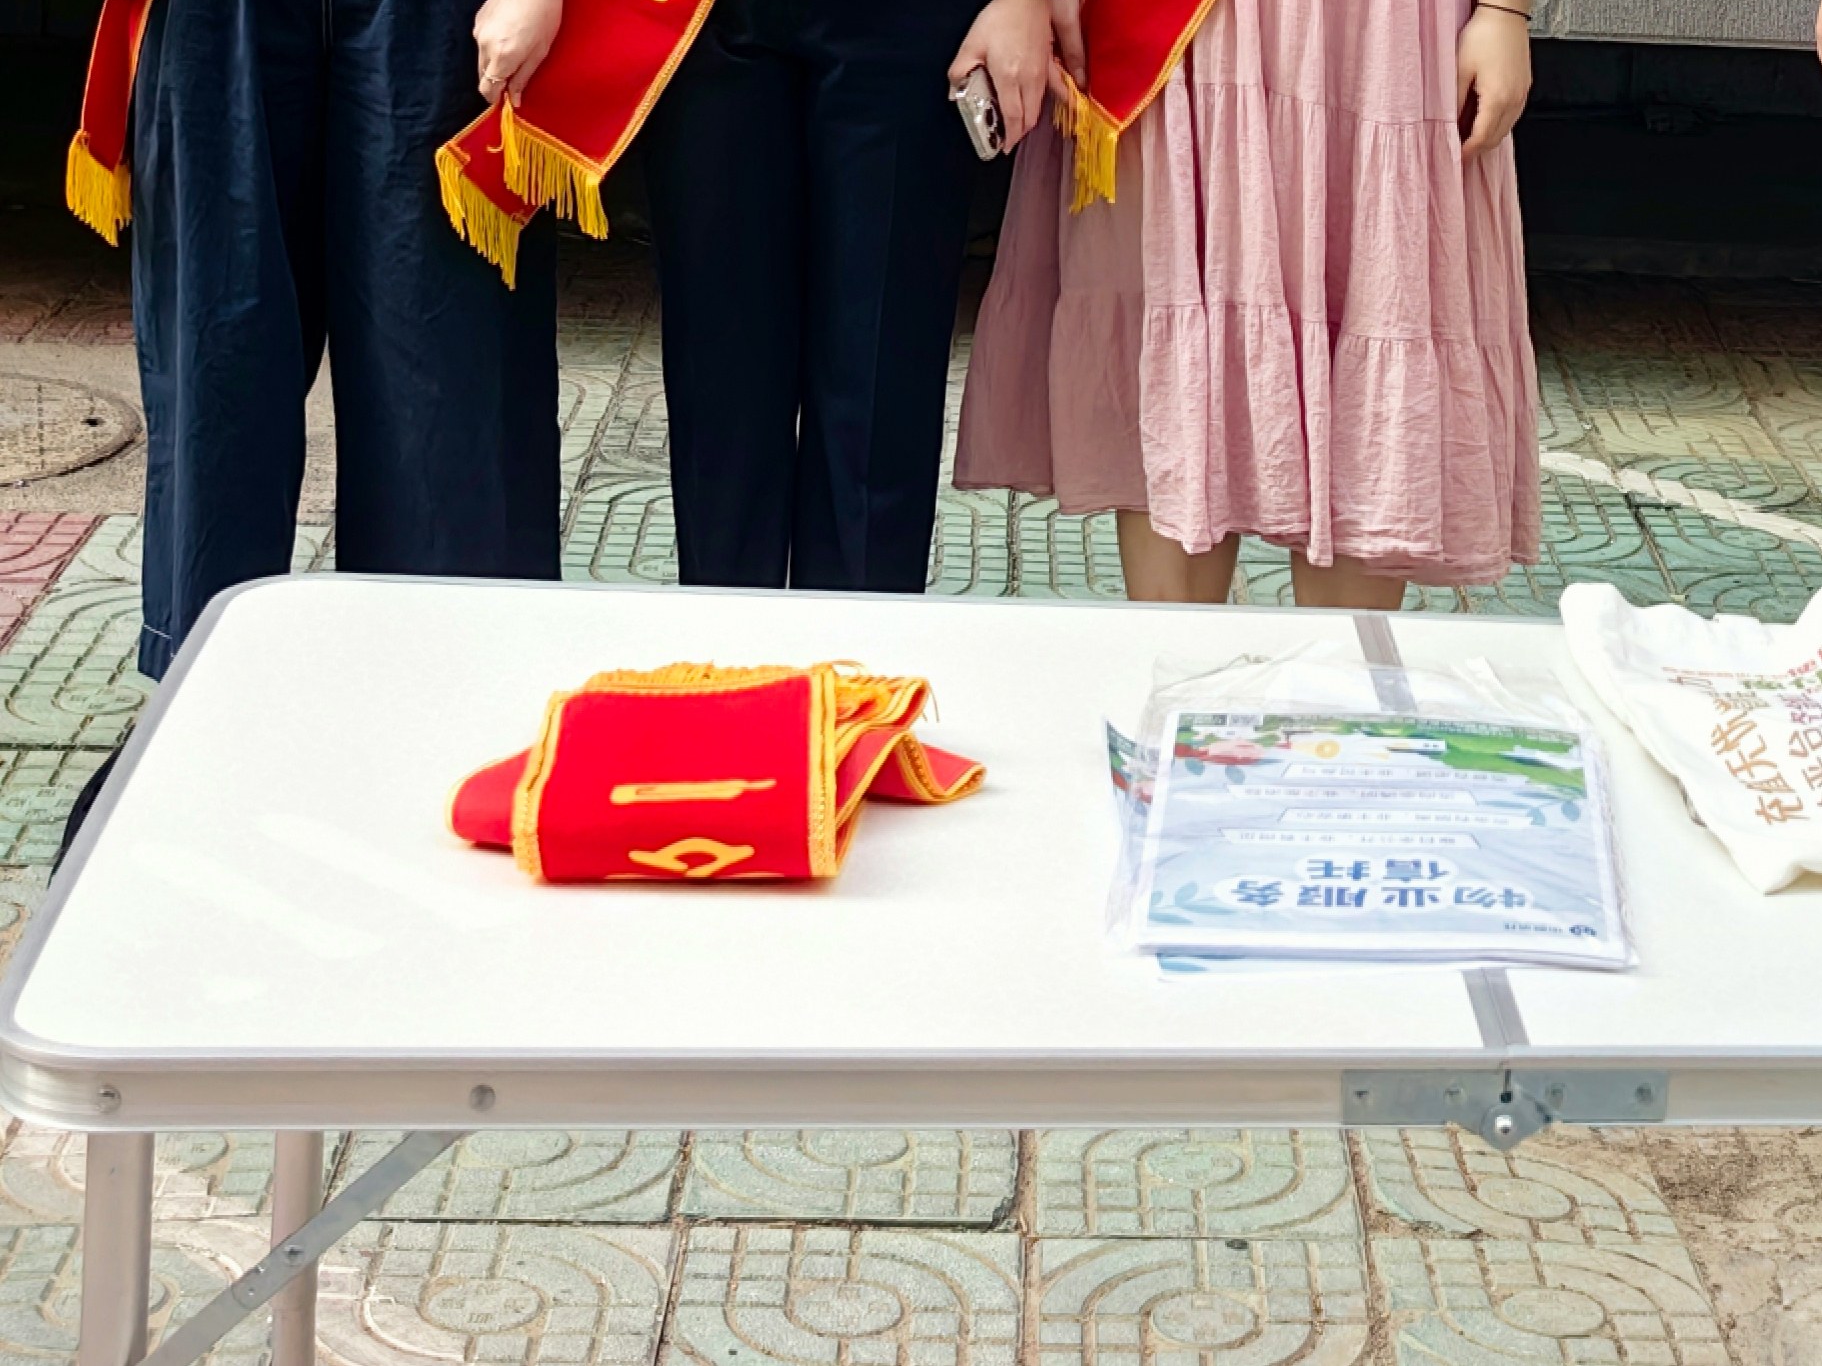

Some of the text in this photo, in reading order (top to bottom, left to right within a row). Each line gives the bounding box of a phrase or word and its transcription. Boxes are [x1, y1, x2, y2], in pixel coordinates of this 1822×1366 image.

[1306, 857, 1451, 883] 信托
[1230, 879, 1527, 908] 物业服务
